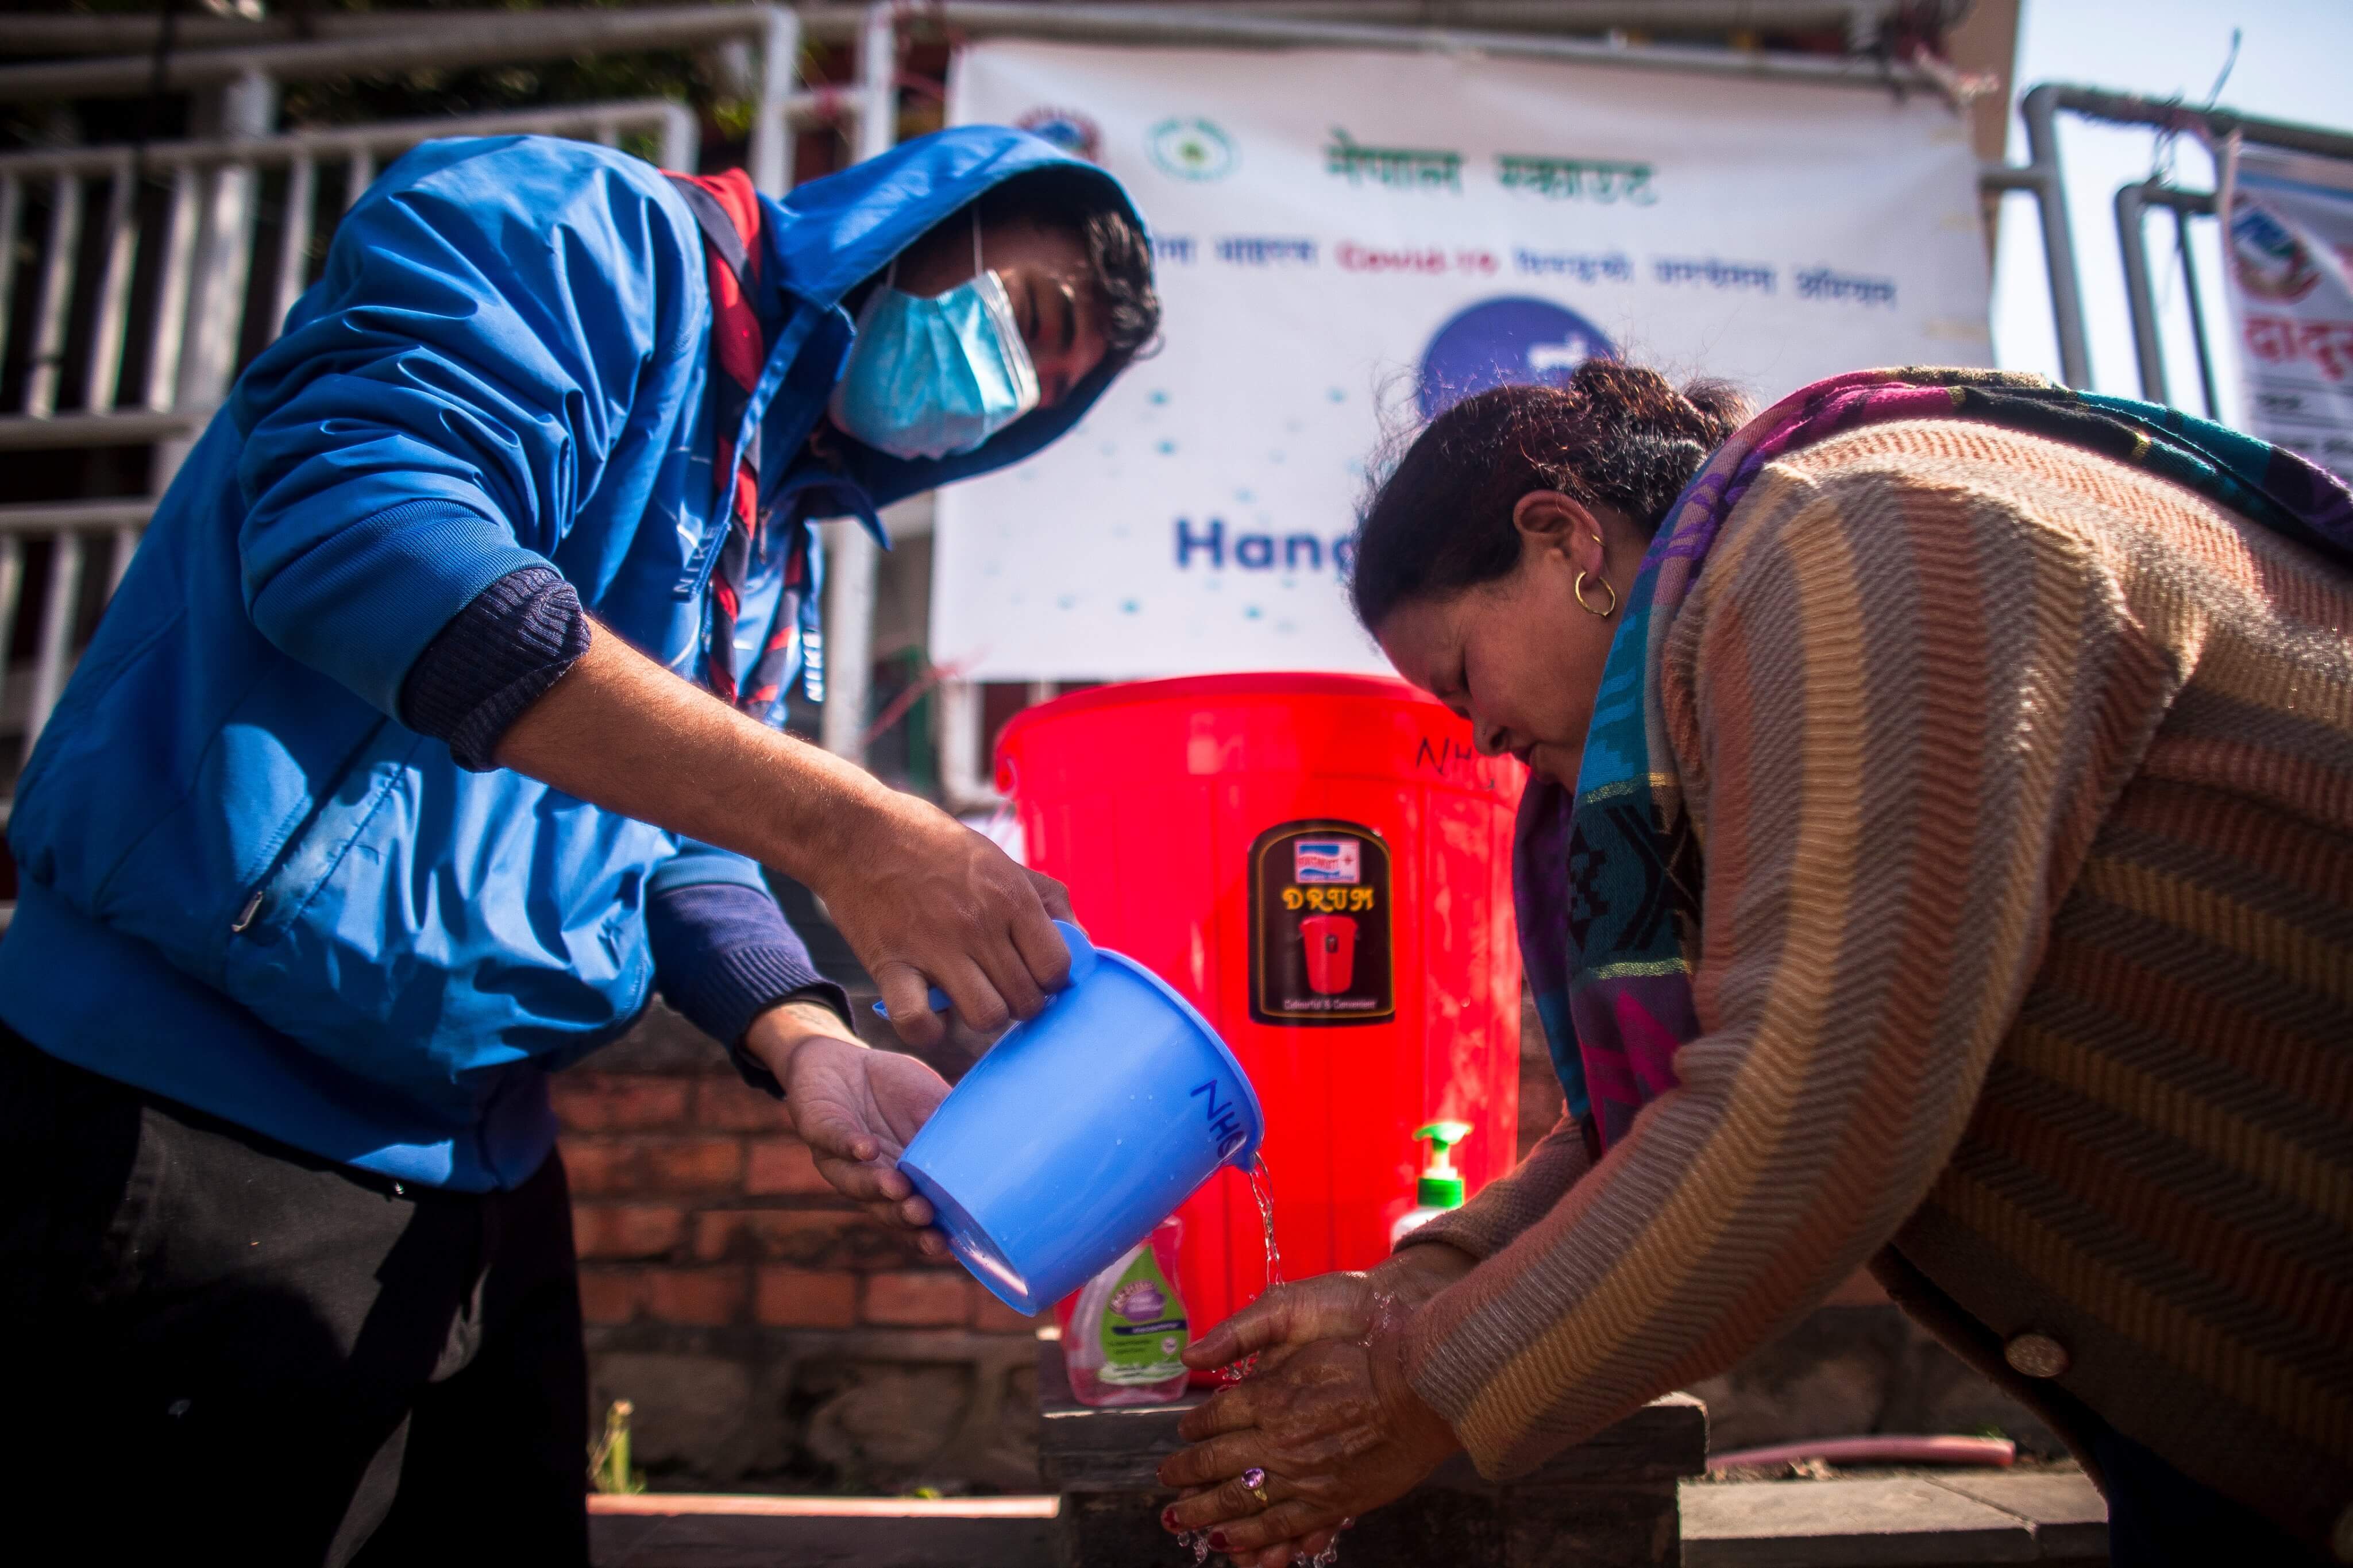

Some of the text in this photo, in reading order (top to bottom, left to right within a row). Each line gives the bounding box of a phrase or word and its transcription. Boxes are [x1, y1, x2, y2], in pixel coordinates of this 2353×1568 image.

[1325, 124, 1658, 206] नेपाल स्काउट
[1282, 886, 1375, 913] DRUM
